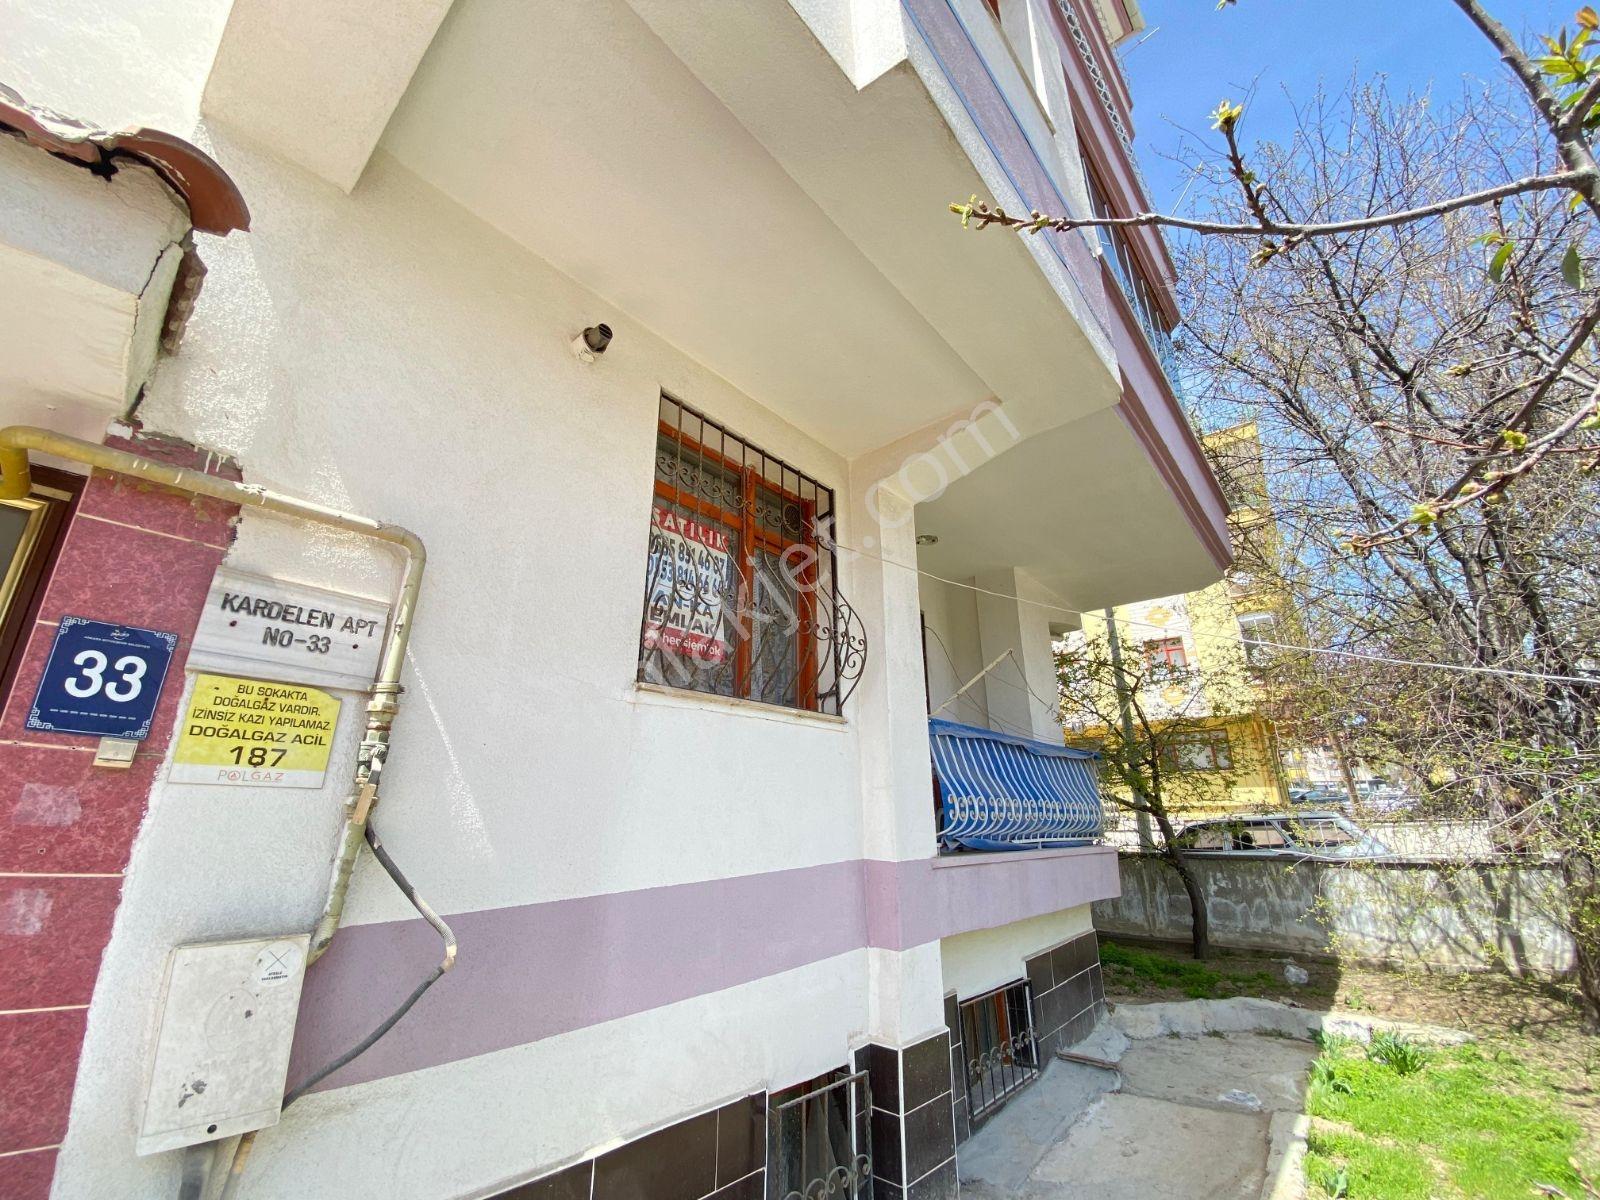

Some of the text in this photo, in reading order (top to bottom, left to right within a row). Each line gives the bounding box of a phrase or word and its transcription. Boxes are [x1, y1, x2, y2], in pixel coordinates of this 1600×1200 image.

[221, 593, 378, 638] KARDELEN APT
[650, 604, 717, 635] EMLAK
[262, 626, 332, 654] NO-33
[64, 649, 147, 703] 33
[237, 684, 308, 701] BU SOKAKTA
[192, 706, 235, 722] İZİNSİZ
[239, 713, 265, 725] KAZI
[213, 695, 321, 717] DOĞALGAZ VARDIR.
[189, 724, 326, 746] DOĞALGAZ ACİL
[230, 745, 288, 768] 187
[217, 769, 284, 783] POLGAZ
